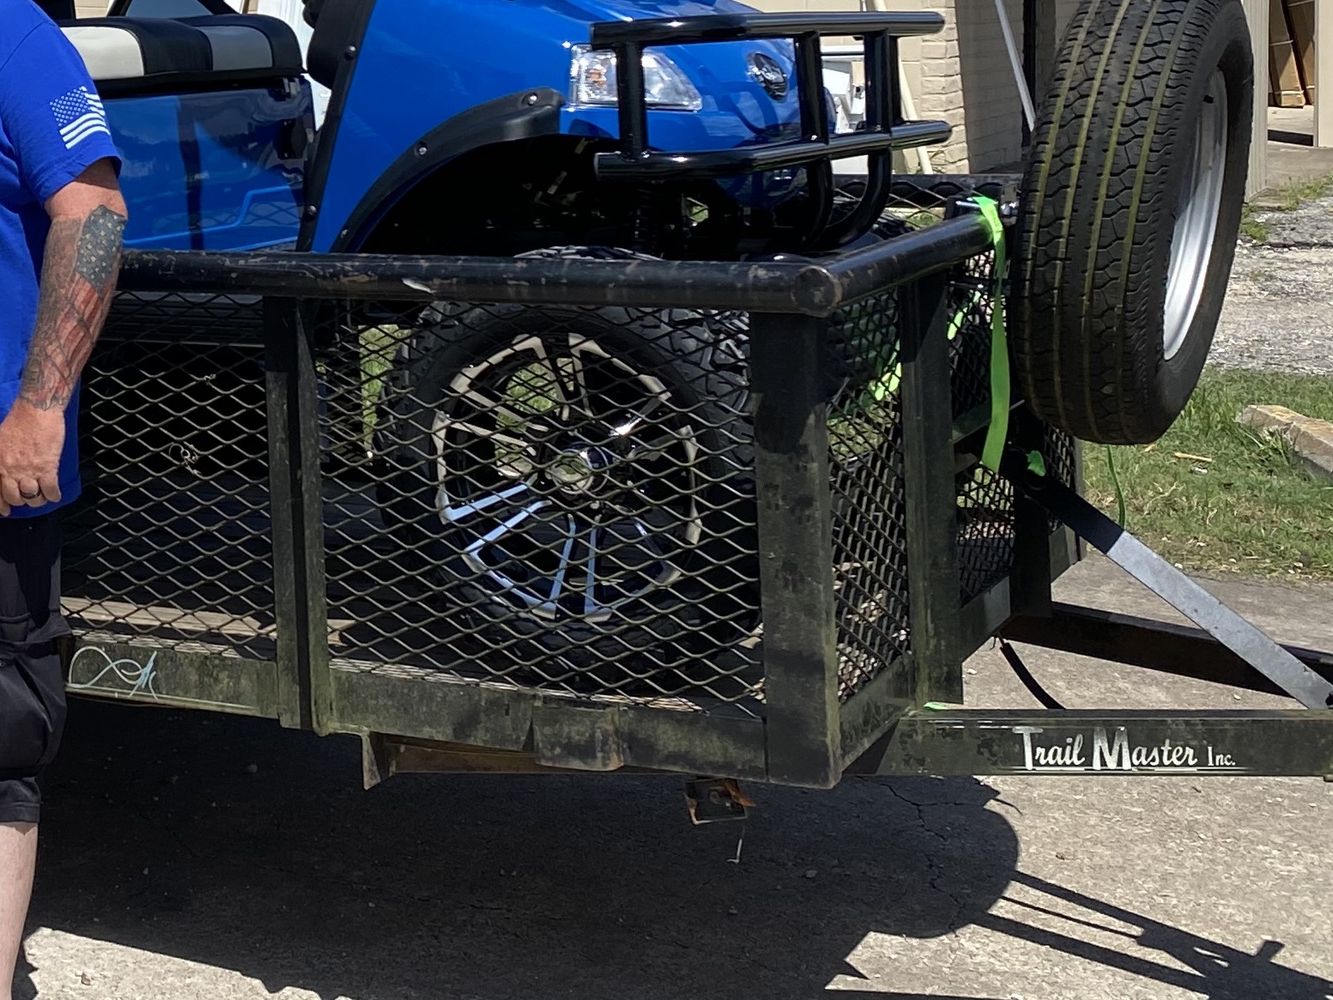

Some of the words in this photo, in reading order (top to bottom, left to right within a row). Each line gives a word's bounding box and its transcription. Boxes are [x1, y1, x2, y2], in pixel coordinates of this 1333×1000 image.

[1012, 726, 1086, 770] Trail
[1092, 726, 1199, 770] Master
[1207, 746, 1236, 766] Inc.
